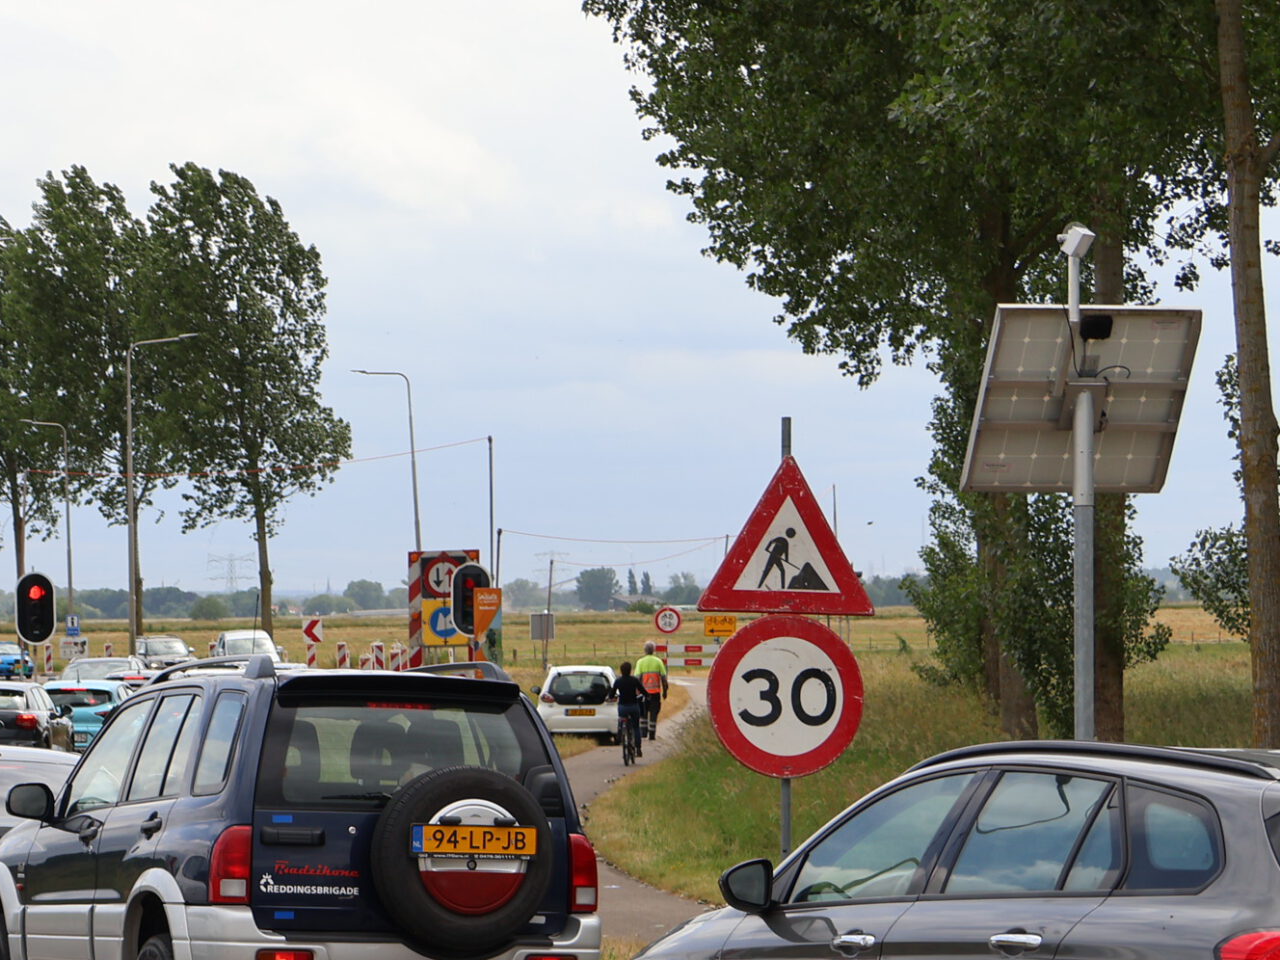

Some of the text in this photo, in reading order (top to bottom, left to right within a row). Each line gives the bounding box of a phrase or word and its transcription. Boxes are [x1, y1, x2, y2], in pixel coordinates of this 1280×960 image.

[738, 667, 837, 727] 30
[432, 829, 527, 850] 94-LP-JB
[267, 884, 359, 896] REDDINGSBRIGADE
